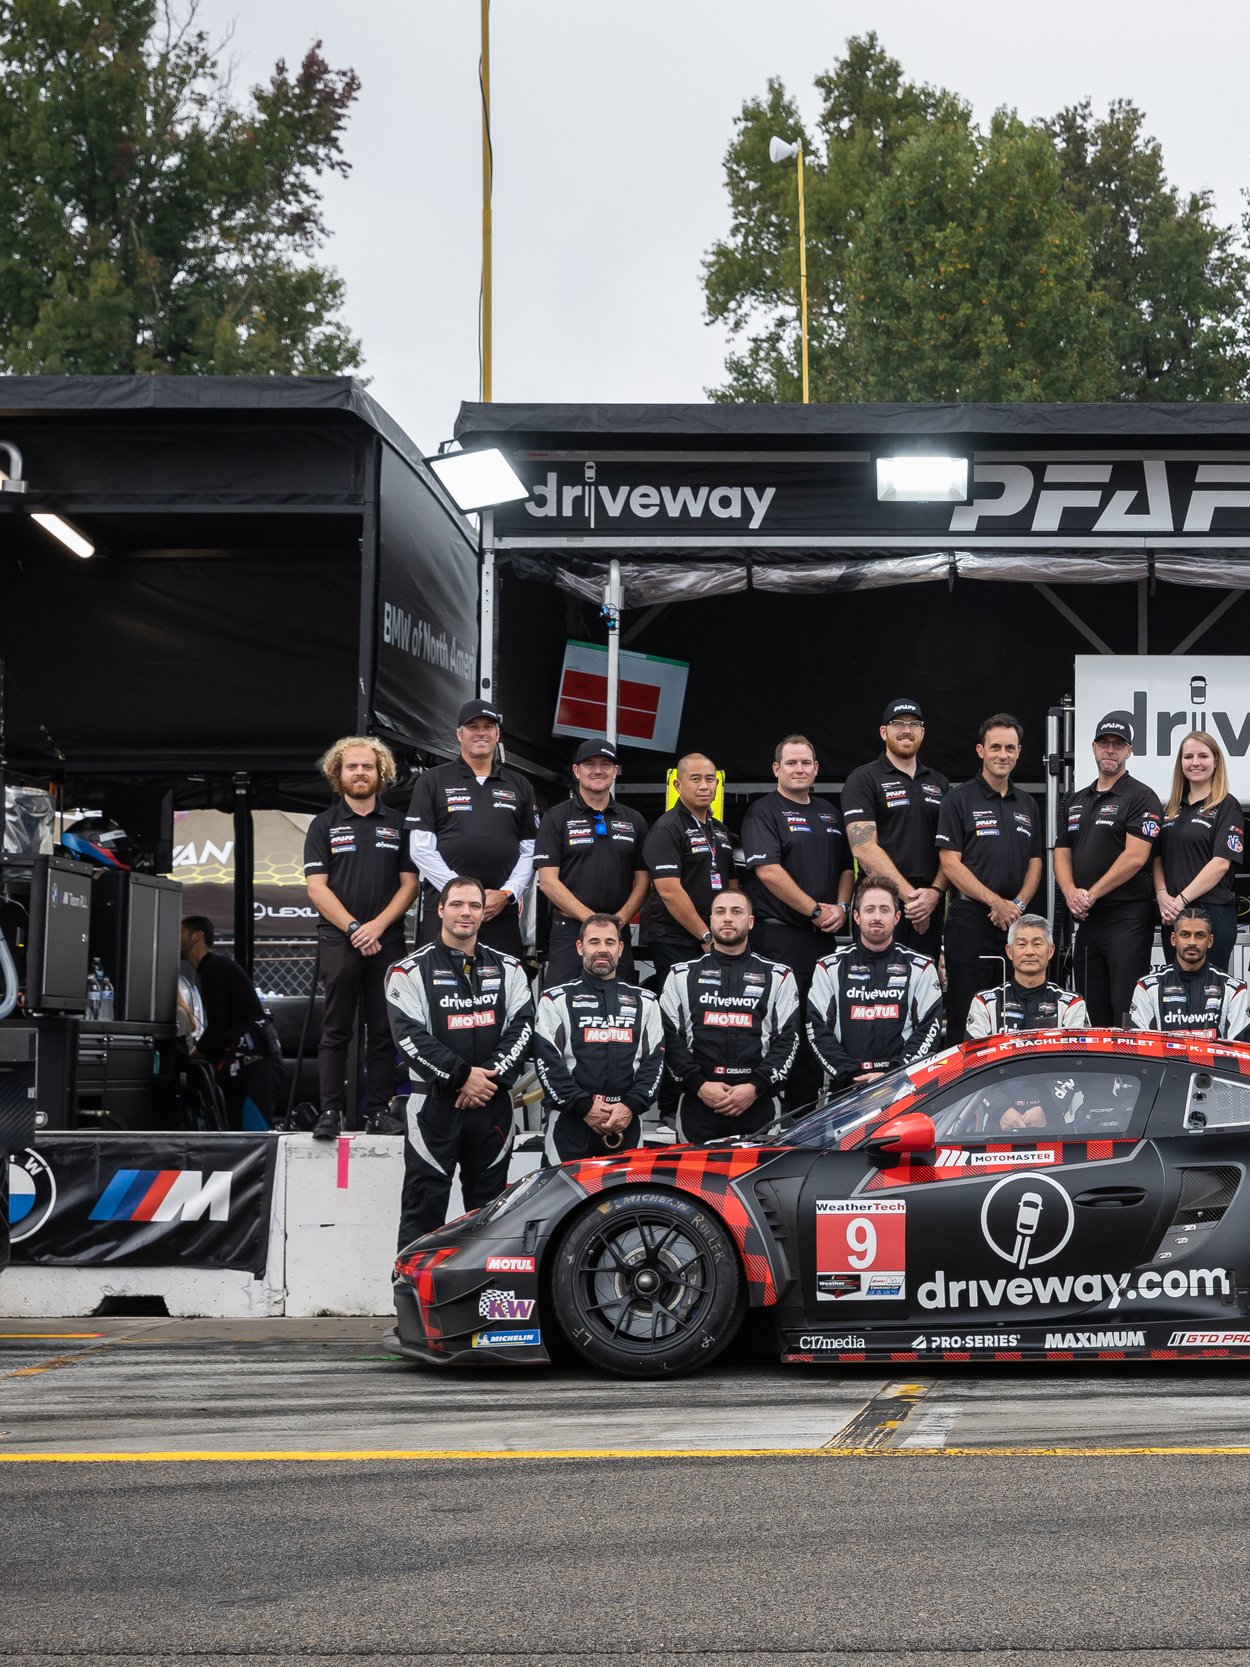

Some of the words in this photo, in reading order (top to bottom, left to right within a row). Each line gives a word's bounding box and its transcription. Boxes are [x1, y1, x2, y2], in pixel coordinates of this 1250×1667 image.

[524, 466, 776, 529] driveway
[383, 601, 411, 652] BMW
[423, 621, 449, 670] North
[893, 704, 917, 712] PFAFF
[699, 990, 760, 1010] driveway
[846, 985, 905, 1002] driveway
[439, 993, 499, 1009] driveway
[853, 1005, 898, 1018] MOTUL
[450, 1012, 494, 1028] MOTUL
[578, 1014, 636, 1029] PFAFF
[706, 1013, 751, 1025] MOTUL
[586, 1030, 631, 1041] MOTUL
[1117, 1038, 1155, 1046] PILET
[975, 1153, 1051, 1163] MOTOMASTER
[622, 1194, 691, 1212] MICHELIN
[816, 1203, 906, 1212] WeatherTech
[845, 1217, 877, 1269] 9
[487, 1258, 534, 1271] MOTUL
[917, 1267, 1230, 1309] driveway.com
[487, 1299, 535, 1319] KW
[490, 1332, 534, 1344] MICHELIN
[799, 1335, 866, 1349] C17media
[1186, 1334, 1221, 1343] GTD
